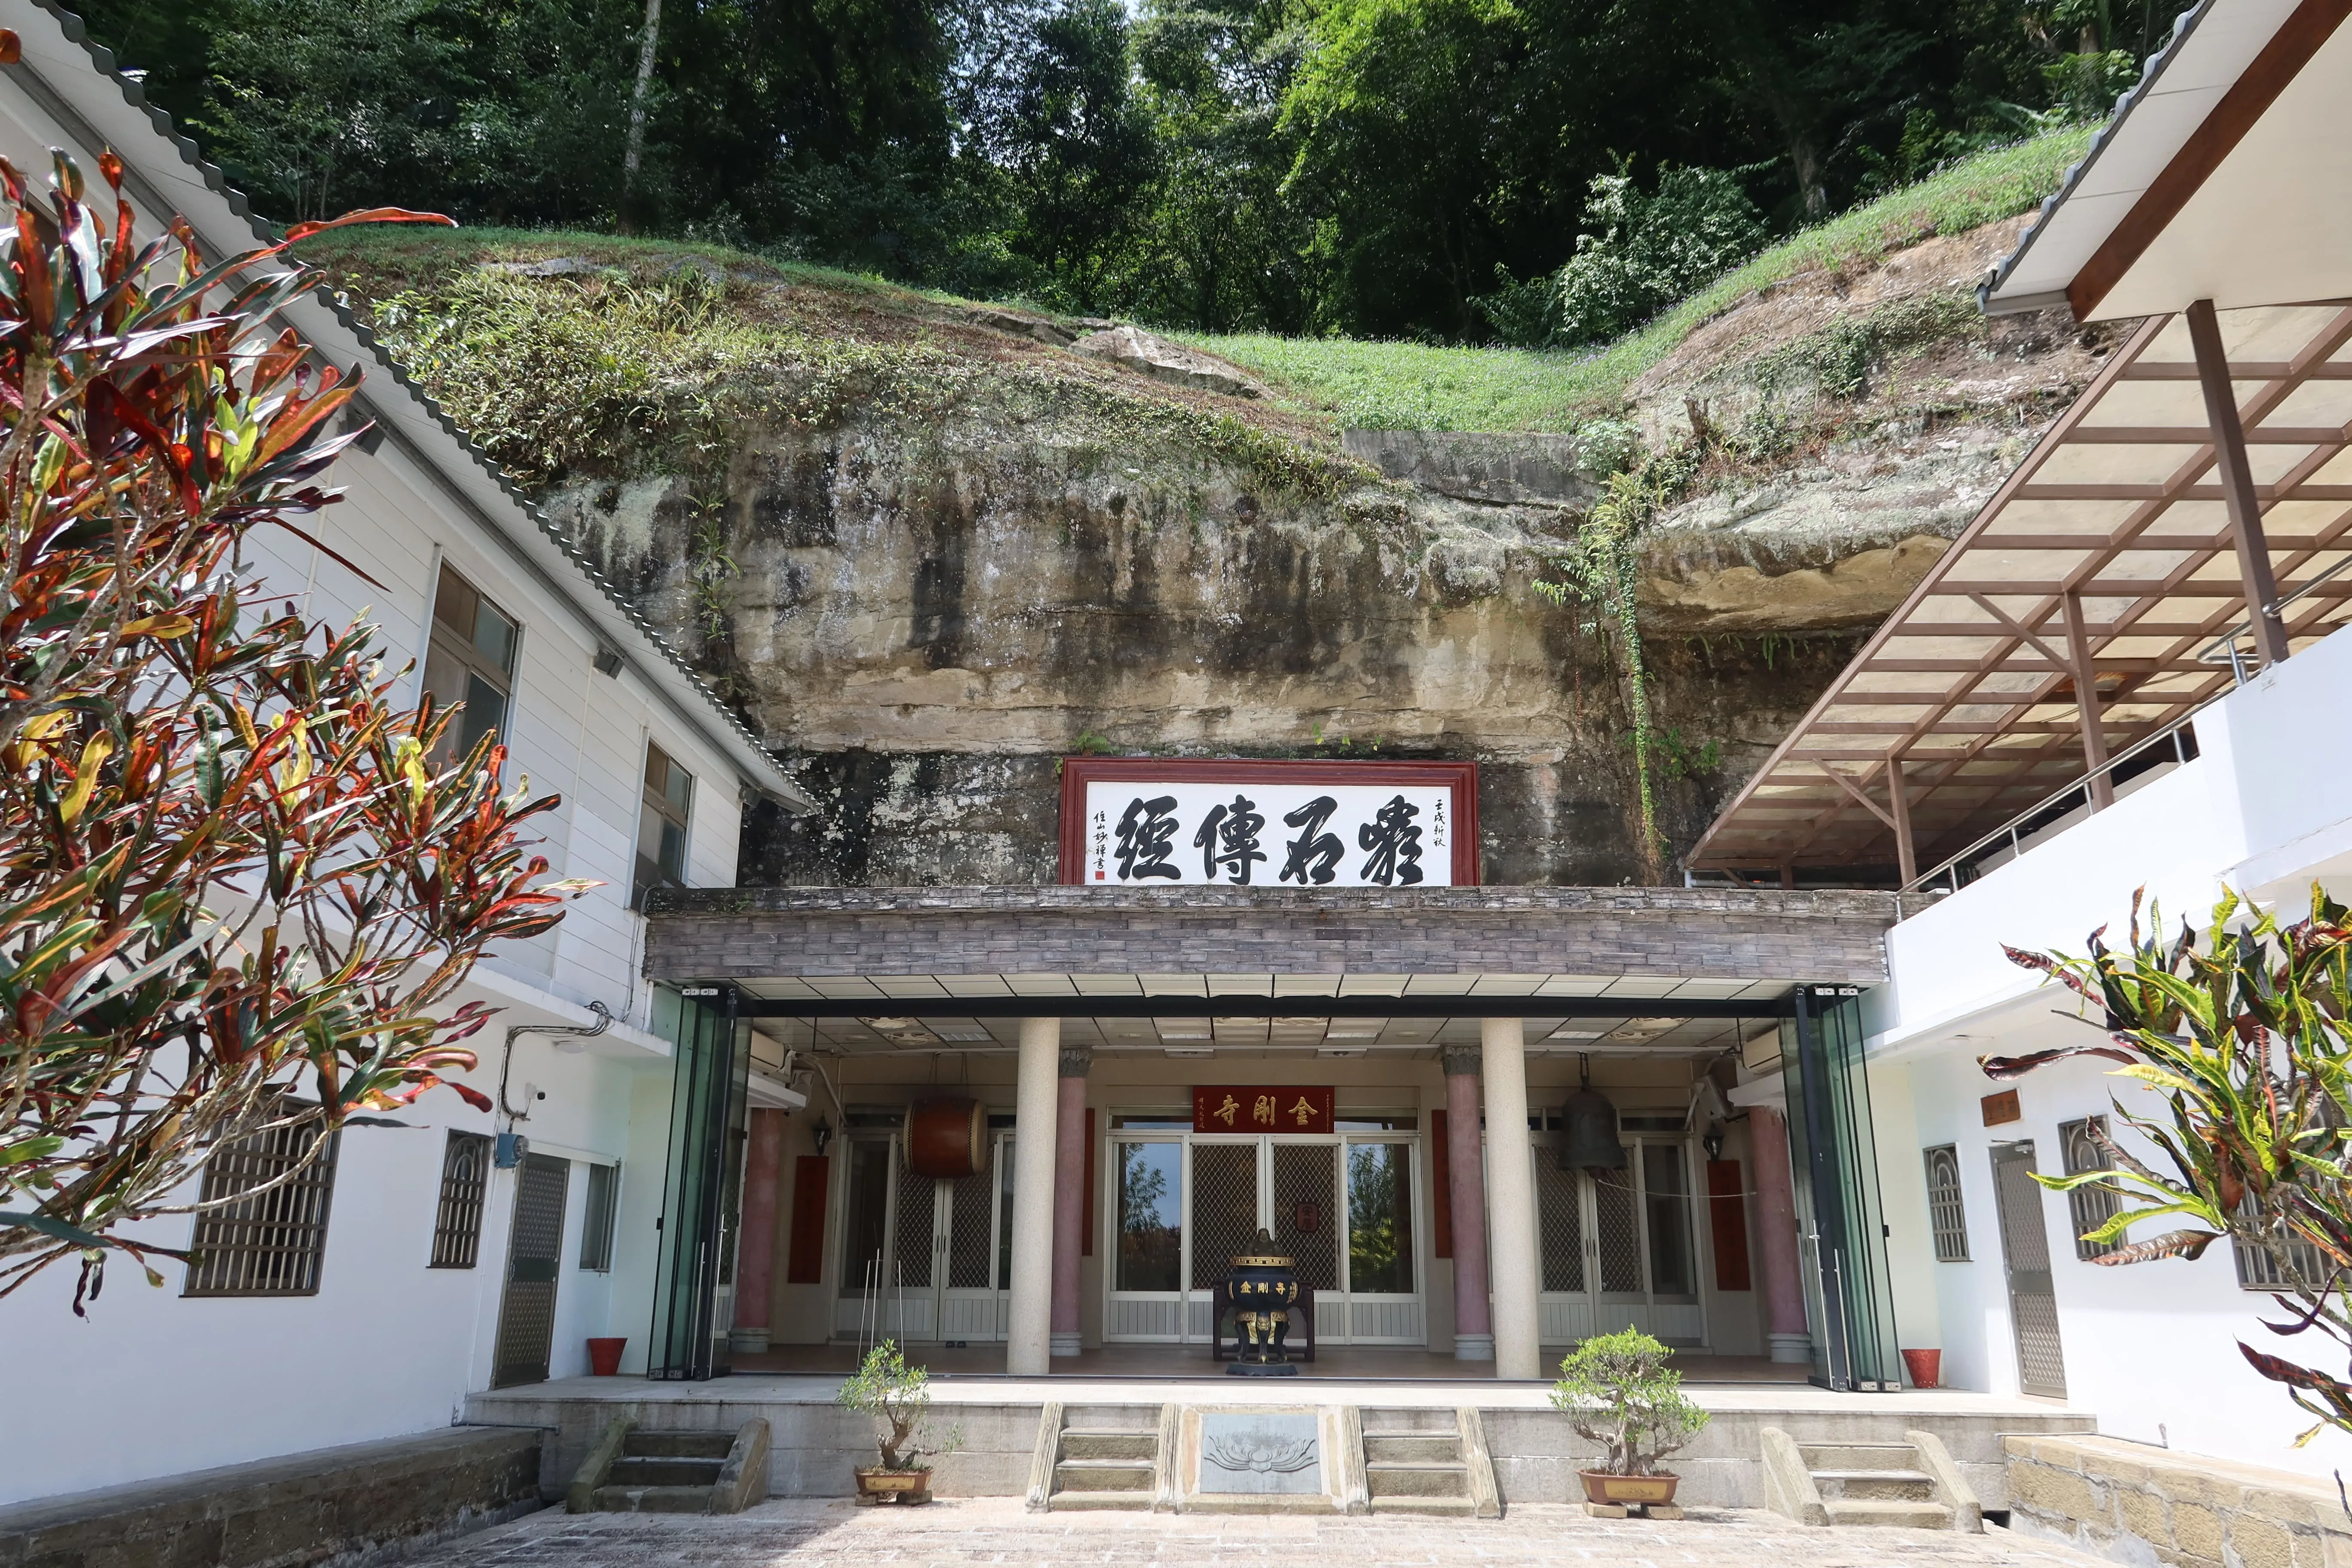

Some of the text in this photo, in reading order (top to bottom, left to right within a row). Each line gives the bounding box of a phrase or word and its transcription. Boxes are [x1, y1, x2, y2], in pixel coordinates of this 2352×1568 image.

[1213, 1094, 1318, 1126] 金剛寺
[1240, 1280, 1286, 1295] 金剛寺
